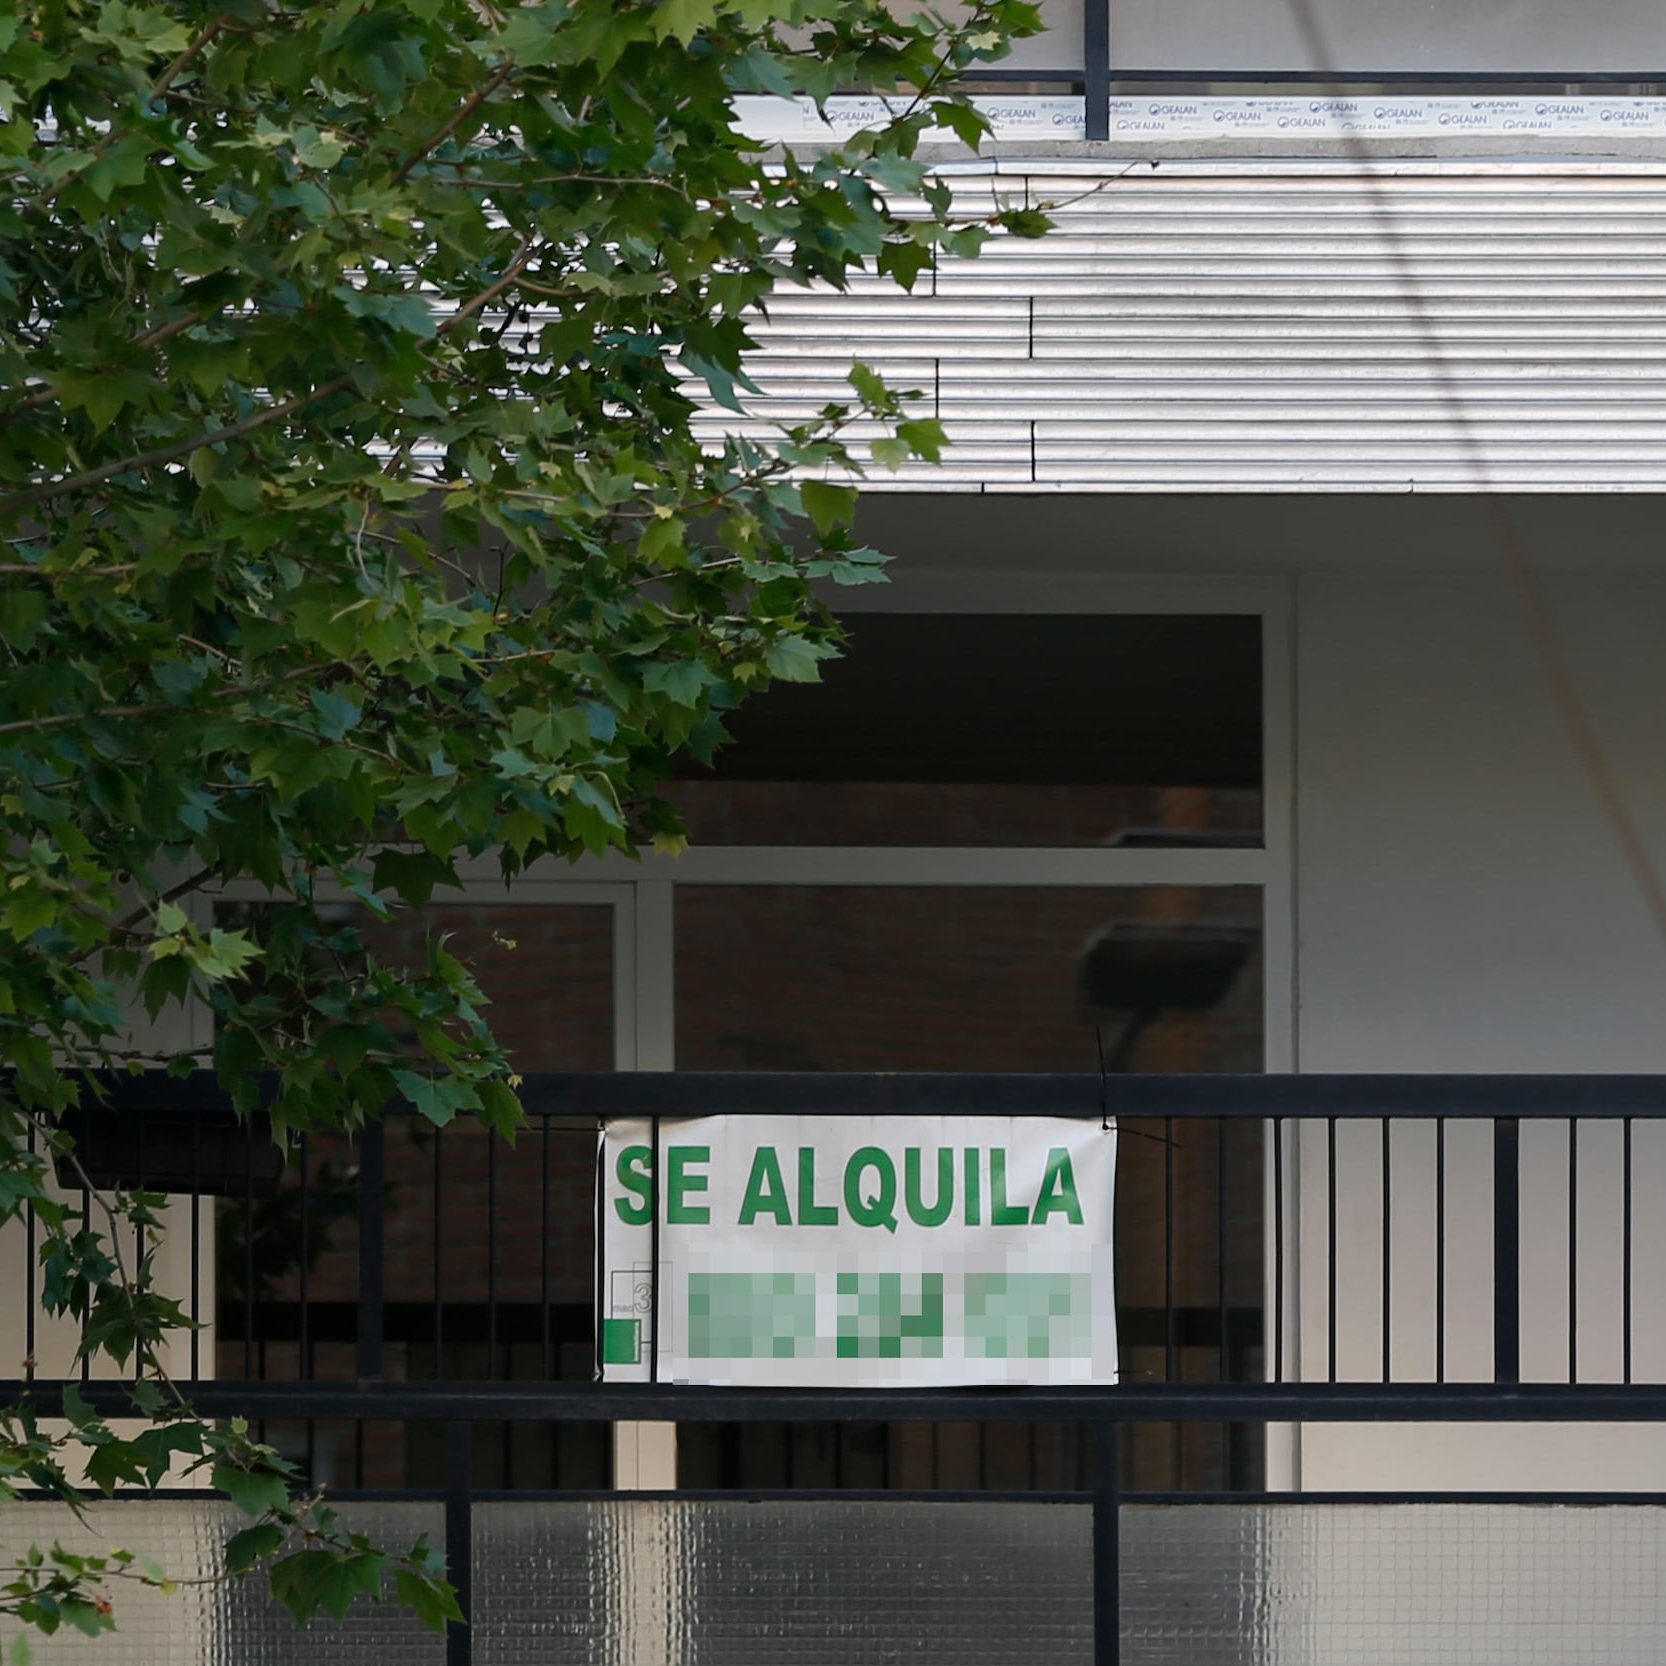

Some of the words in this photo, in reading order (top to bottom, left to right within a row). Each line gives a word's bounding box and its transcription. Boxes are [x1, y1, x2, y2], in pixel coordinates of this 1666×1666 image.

[1162, 105, 1197, 114] GEALAN
[1322, 103, 1358, 112] GEALAN
[1548, 105, 1584, 114] GEALAN
[838, 111, 874, 121] GEALAN
[1001, 109, 1036, 118] GEALAN
[1226, 111, 1261, 120] GEALAN
[1386, 108, 1422, 118] GEALAN
[1612, 111, 1648, 120] GEALAN
[1290, 118, 1325, 127] GEALAN
[1450, 114, 1487, 124] GEALAN
[614, 1145, 710, 1226] SE
[738, 1146, 1084, 1234] ALQUILA
